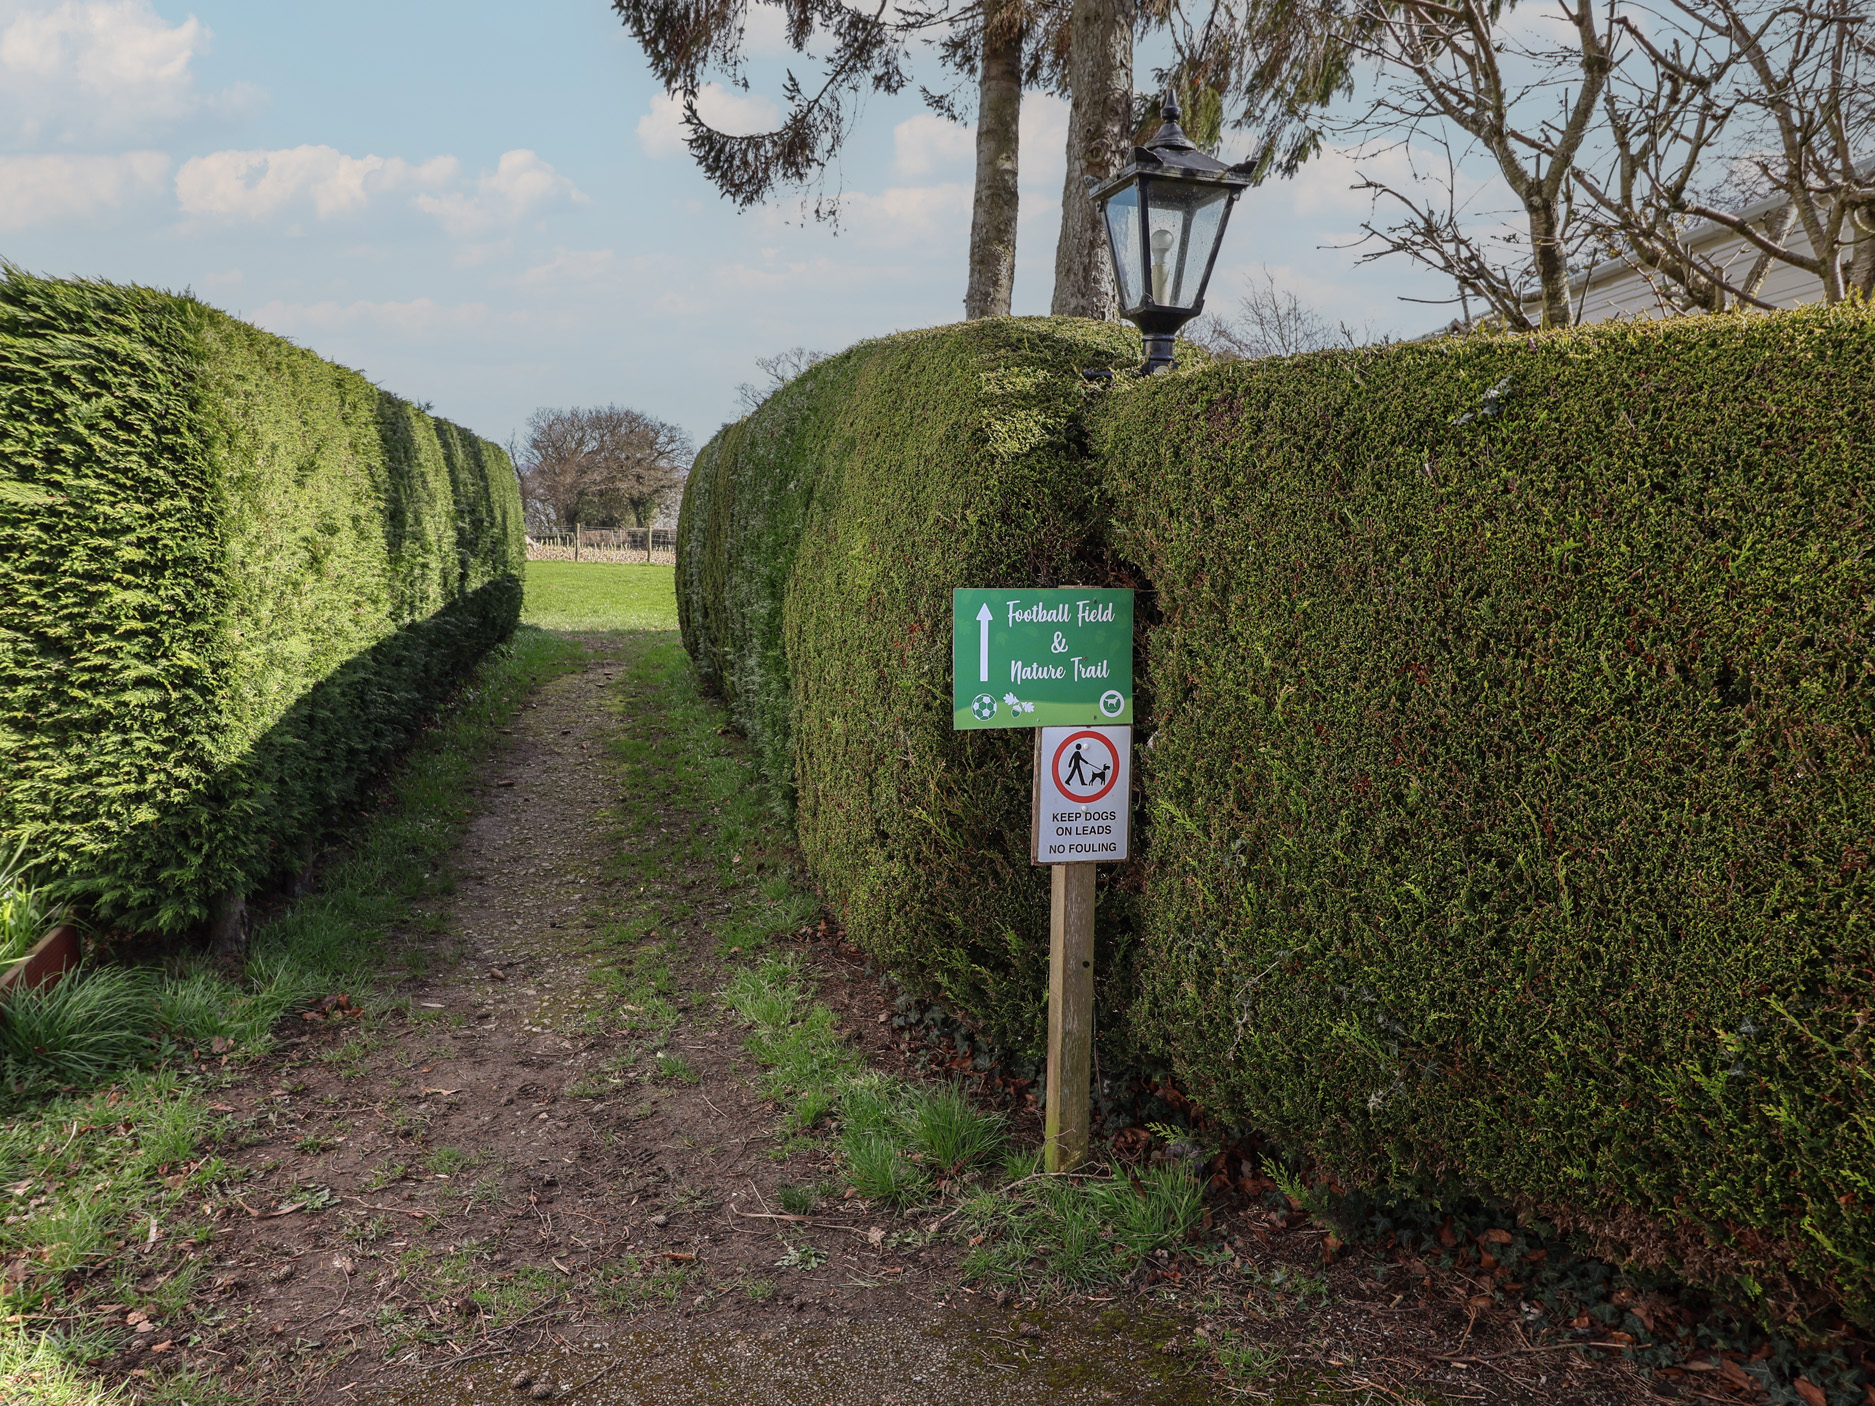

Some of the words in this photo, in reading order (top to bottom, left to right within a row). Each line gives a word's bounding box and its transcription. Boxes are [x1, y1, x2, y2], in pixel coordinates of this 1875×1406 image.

[1006, 600, 1071, 628] Football
[1076, 600, 1115, 627] Field
[1051, 631, 1068, 653] &
[1010, 660, 1066, 685] Nature
[1070, 656, 1110, 682] Trail
[1052, 812, 1081, 822] KEEP
[1084, 811, 1116, 821] DOGS
[1056, 826, 1072, 836] ON
[1075, 825, 1111, 836] LEADS
[1049, 844, 1065, 854] NO
[1069, 842, 1117, 853] FOULING
